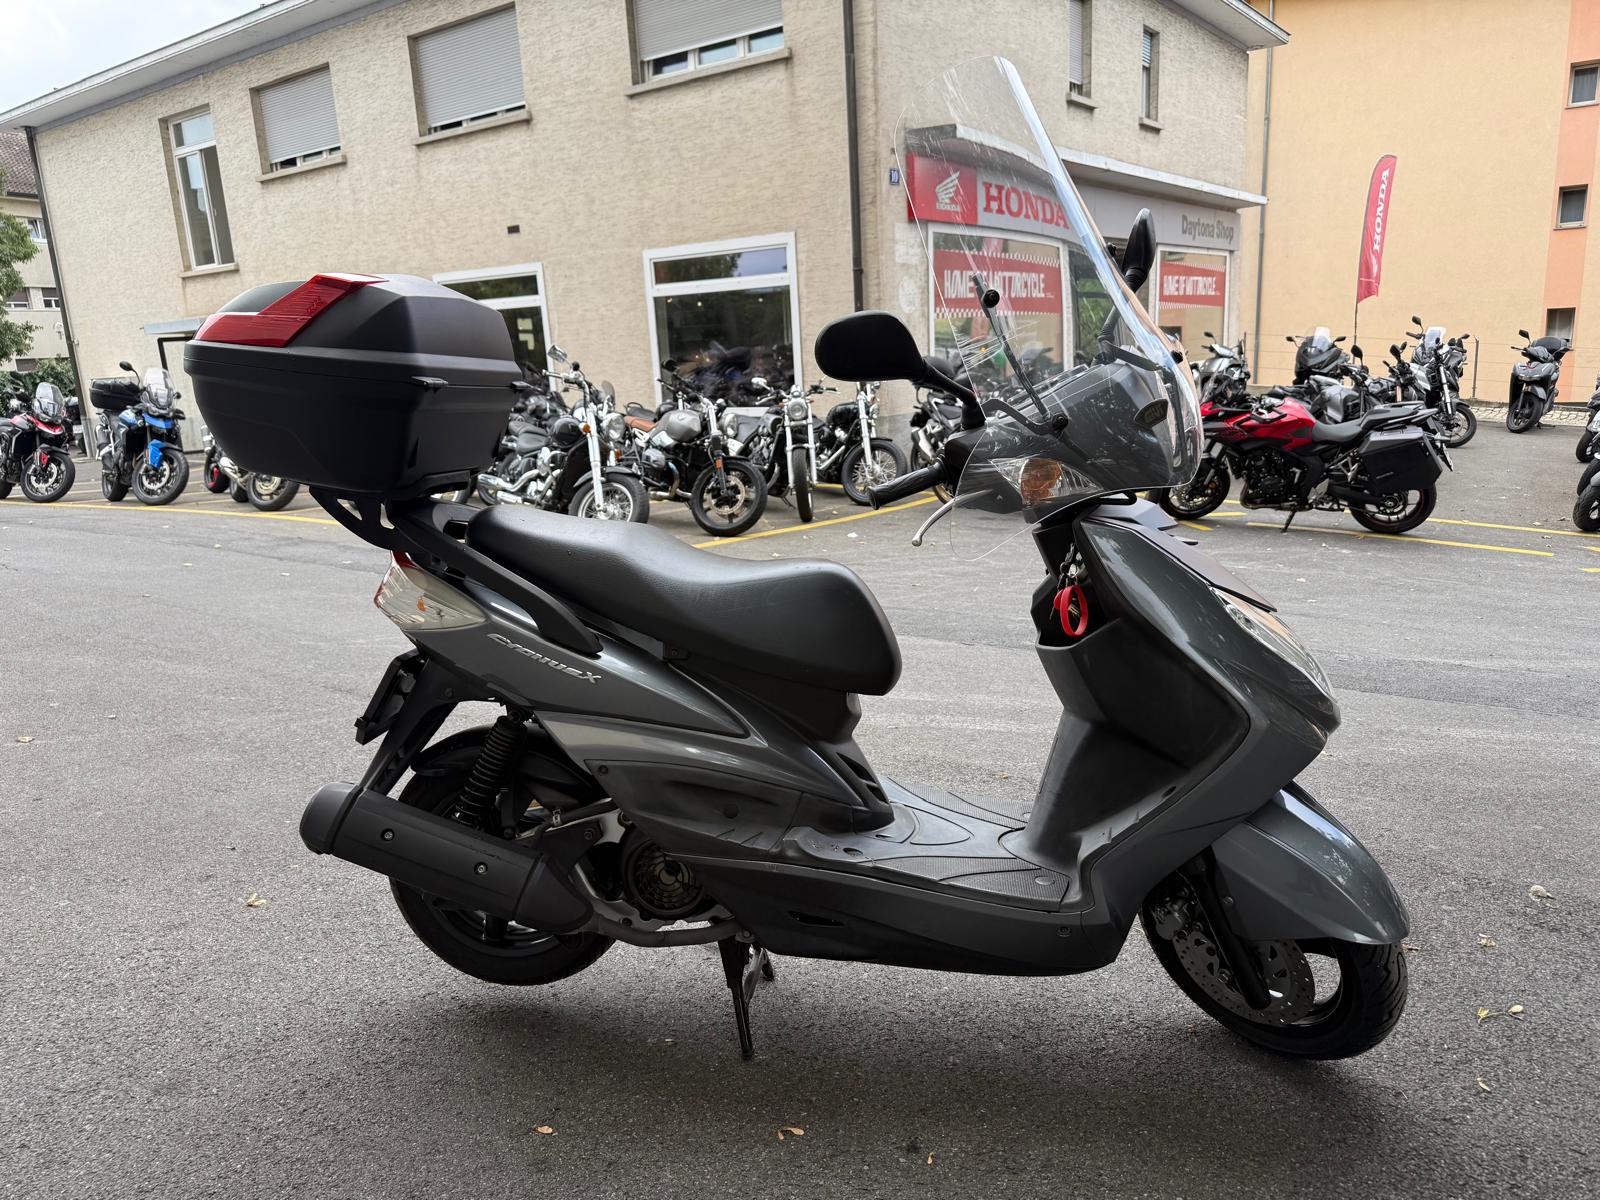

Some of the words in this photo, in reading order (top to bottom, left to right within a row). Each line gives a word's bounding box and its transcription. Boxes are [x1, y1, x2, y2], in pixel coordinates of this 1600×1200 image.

[982, 182, 1070, 229] HONDA
[1182, 214, 1215, 241] Daytona
[1216, 220, 1234, 244] Shop
[1373, 168, 1390, 253] HONDA
